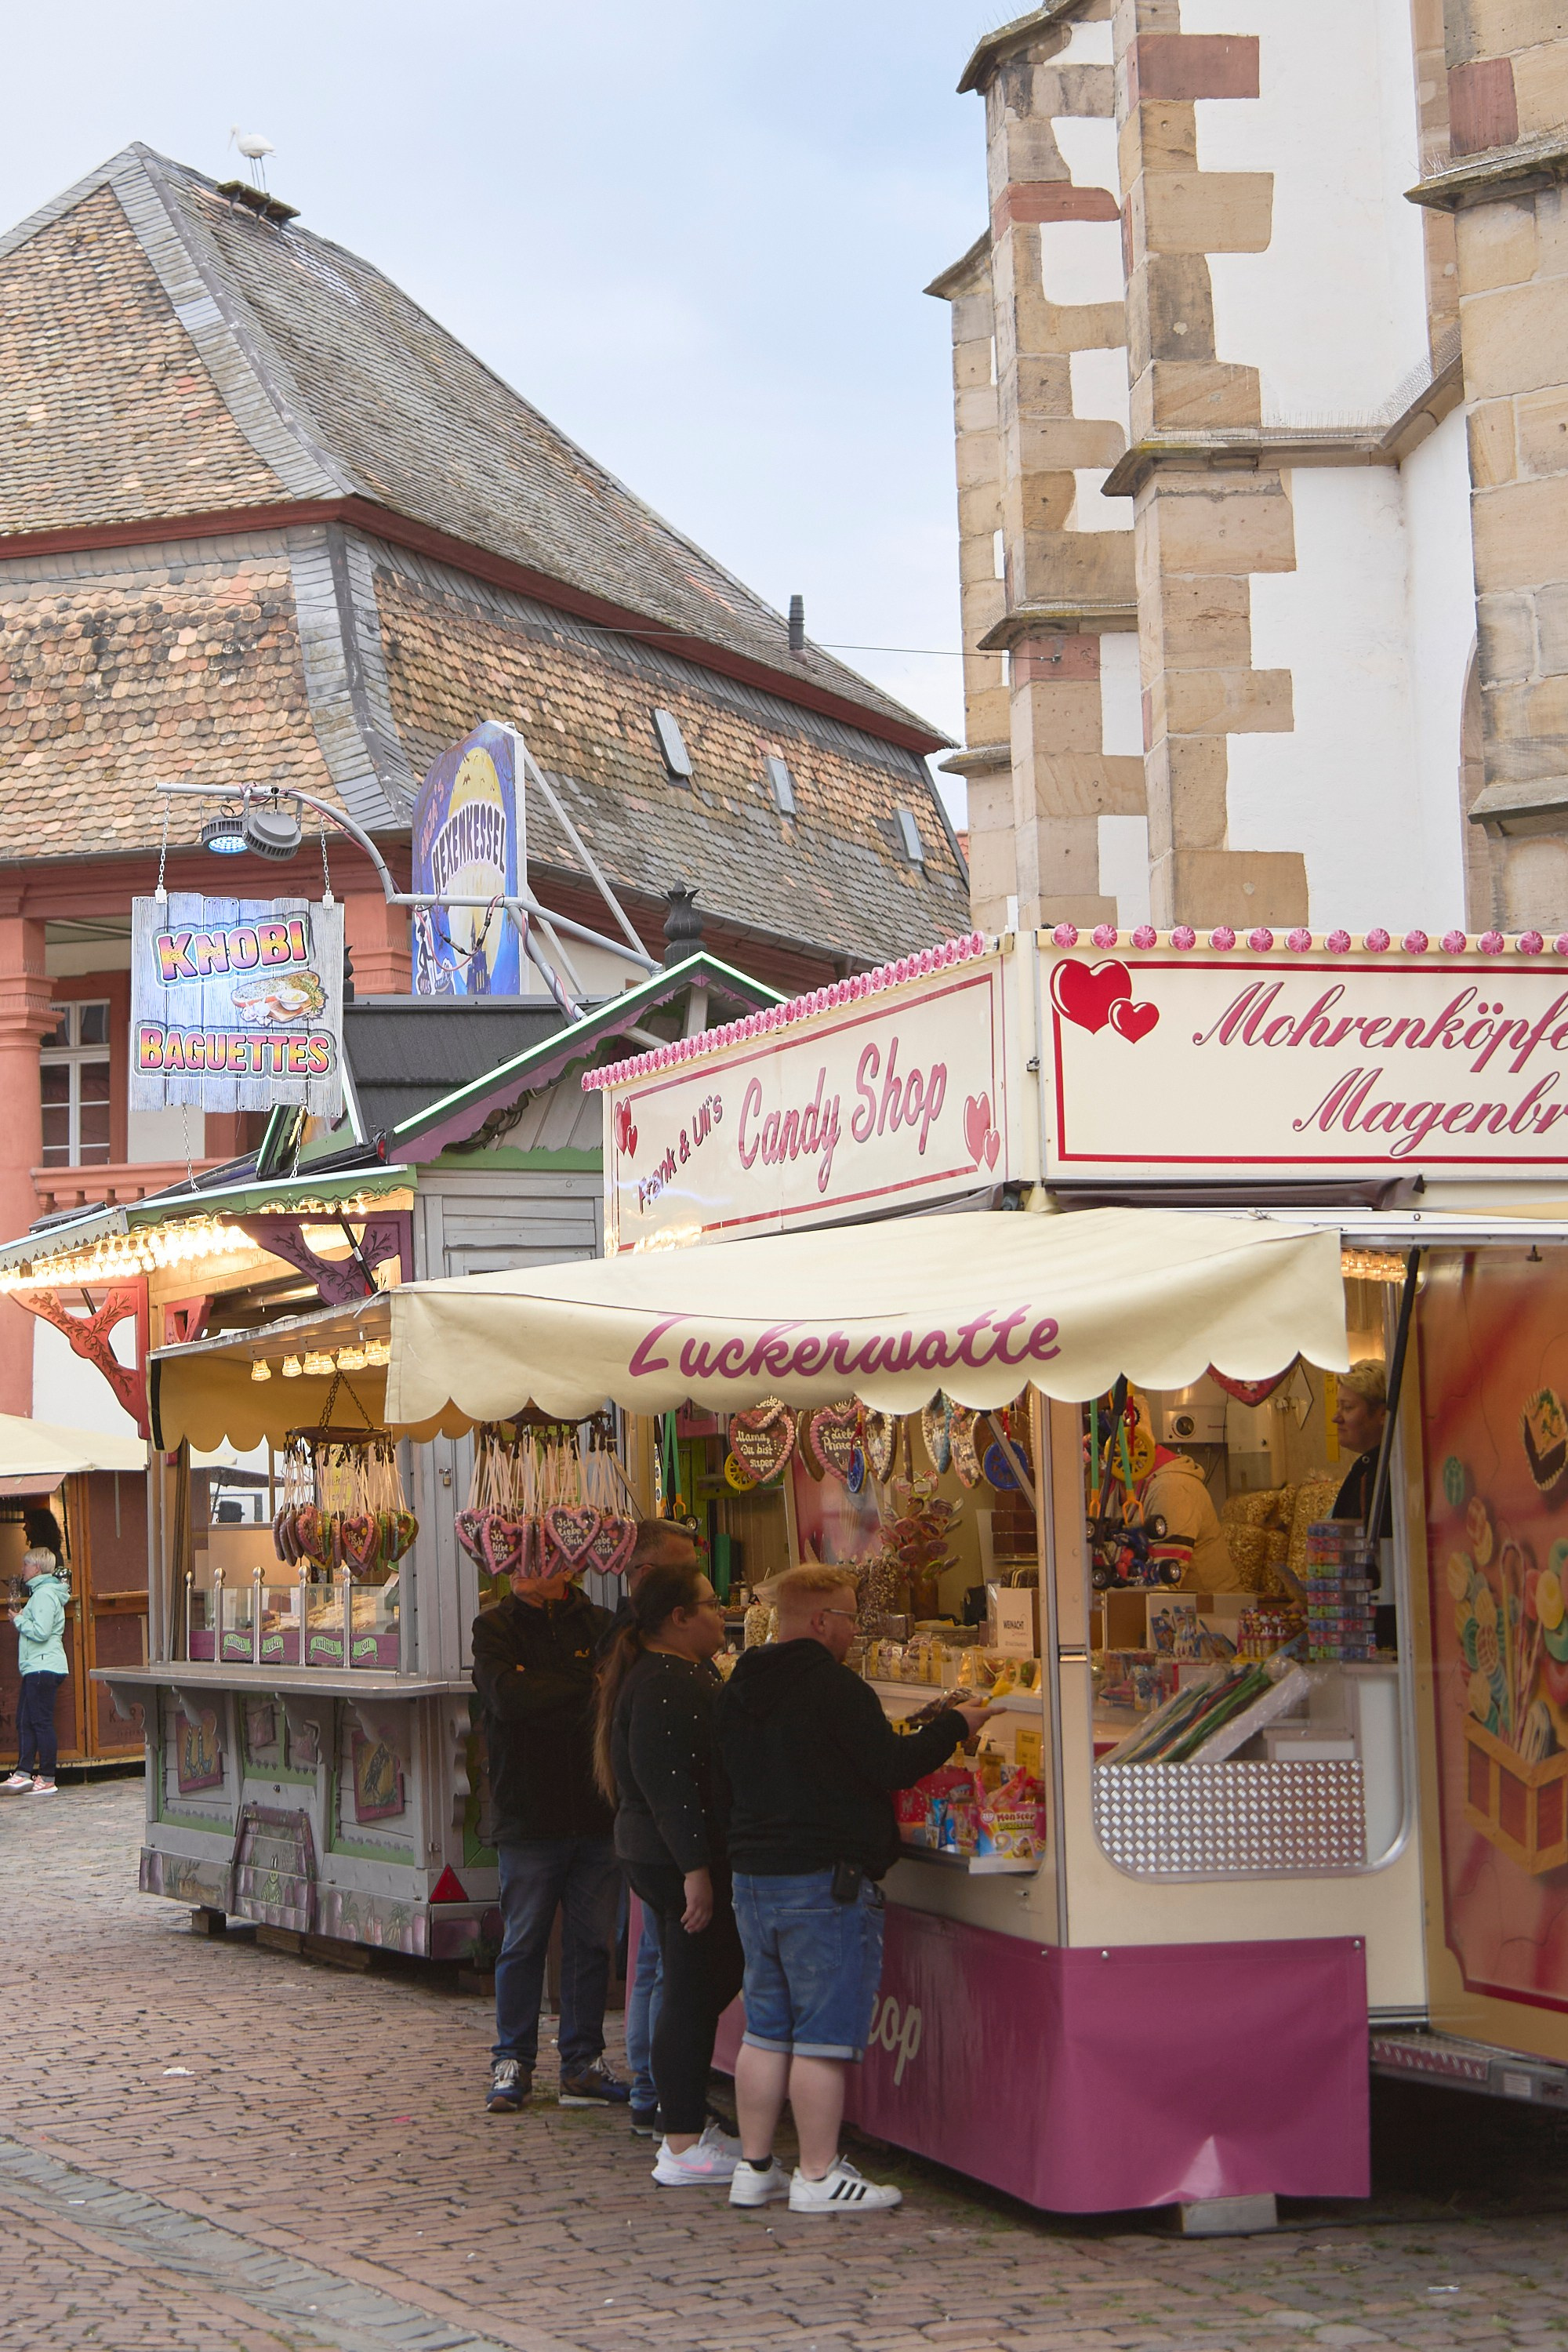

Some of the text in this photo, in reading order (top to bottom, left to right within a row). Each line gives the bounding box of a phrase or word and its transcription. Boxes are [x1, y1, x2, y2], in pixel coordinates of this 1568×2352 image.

[432, 803, 506, 894] HEXENKESSEL
[158, 920, 307, 981] KNOBI
[140, 1028, 330, 1073] BAGUETTES
[739, 1036, 947, 1192] Candy Shop
[638, 1146, 677, 1214] Frank
[679, 1128, 691, 1164] &
[628, 1303, 1062, 1378] Zuckerwatte
[757, 1443, 773, 1456] bist
[830, 1427, 856, 1440] Lieb
[749, 1458, 775, 1472] super
[361, 1640, 371, 1653] gut
[996, 1812, 1036, 1823] Monster
